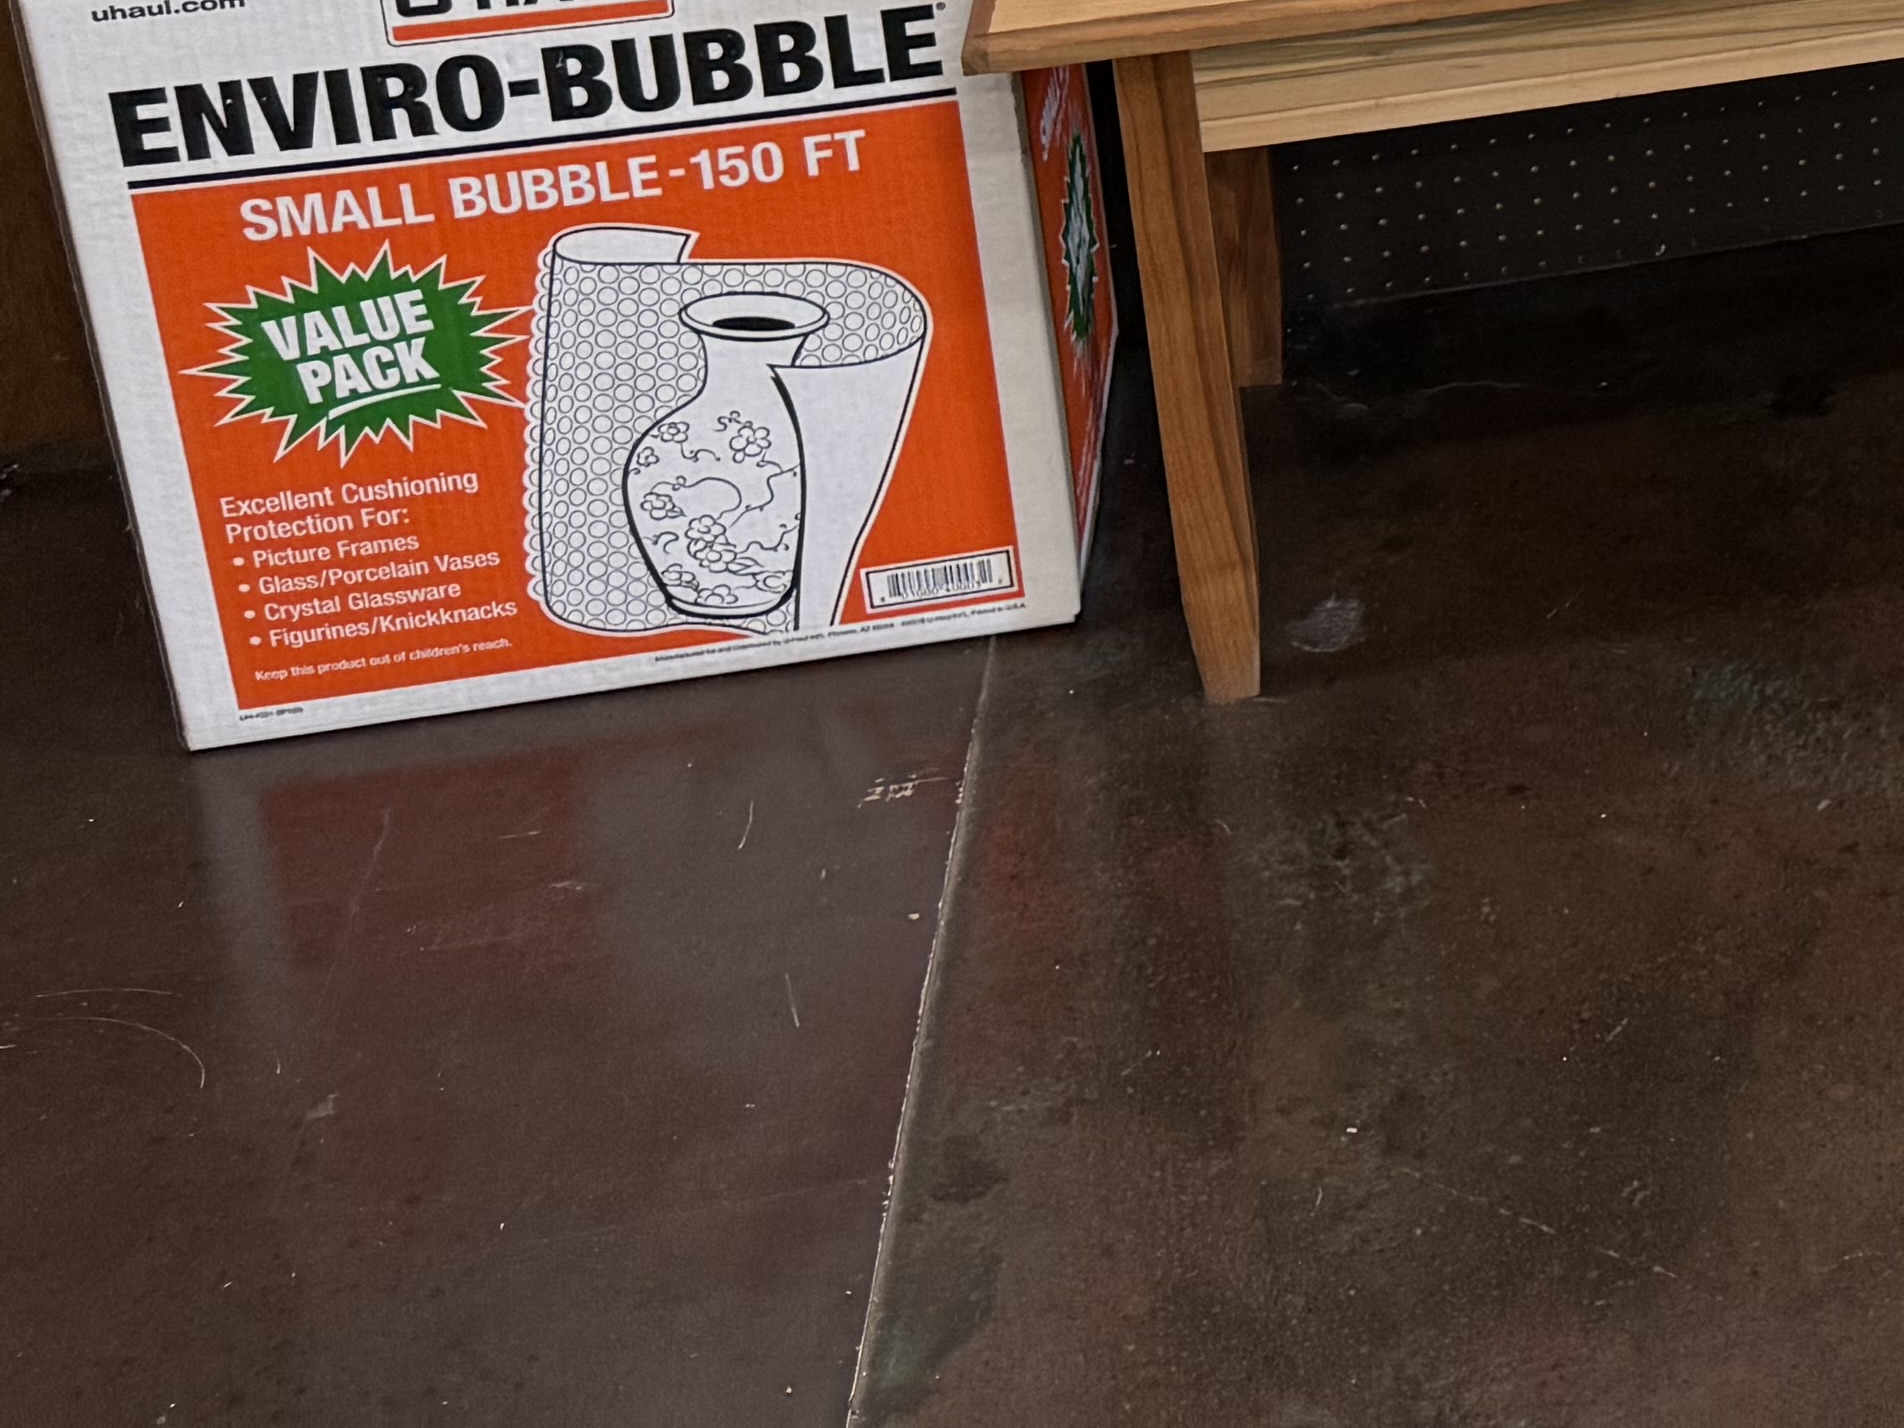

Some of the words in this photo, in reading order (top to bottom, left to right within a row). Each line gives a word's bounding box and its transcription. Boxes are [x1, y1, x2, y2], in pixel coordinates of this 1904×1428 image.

[107, 2, 946, 169] ENVIRO-BUBBLE
[241, 181, 434, 243] SMALL
[804, 129, 866, 179] FT
[260, 288, 436, 360] VALUE
[294, 345, 441, 407] PACK
[269, 600, 517, 648] Figurines/Knickknacks
